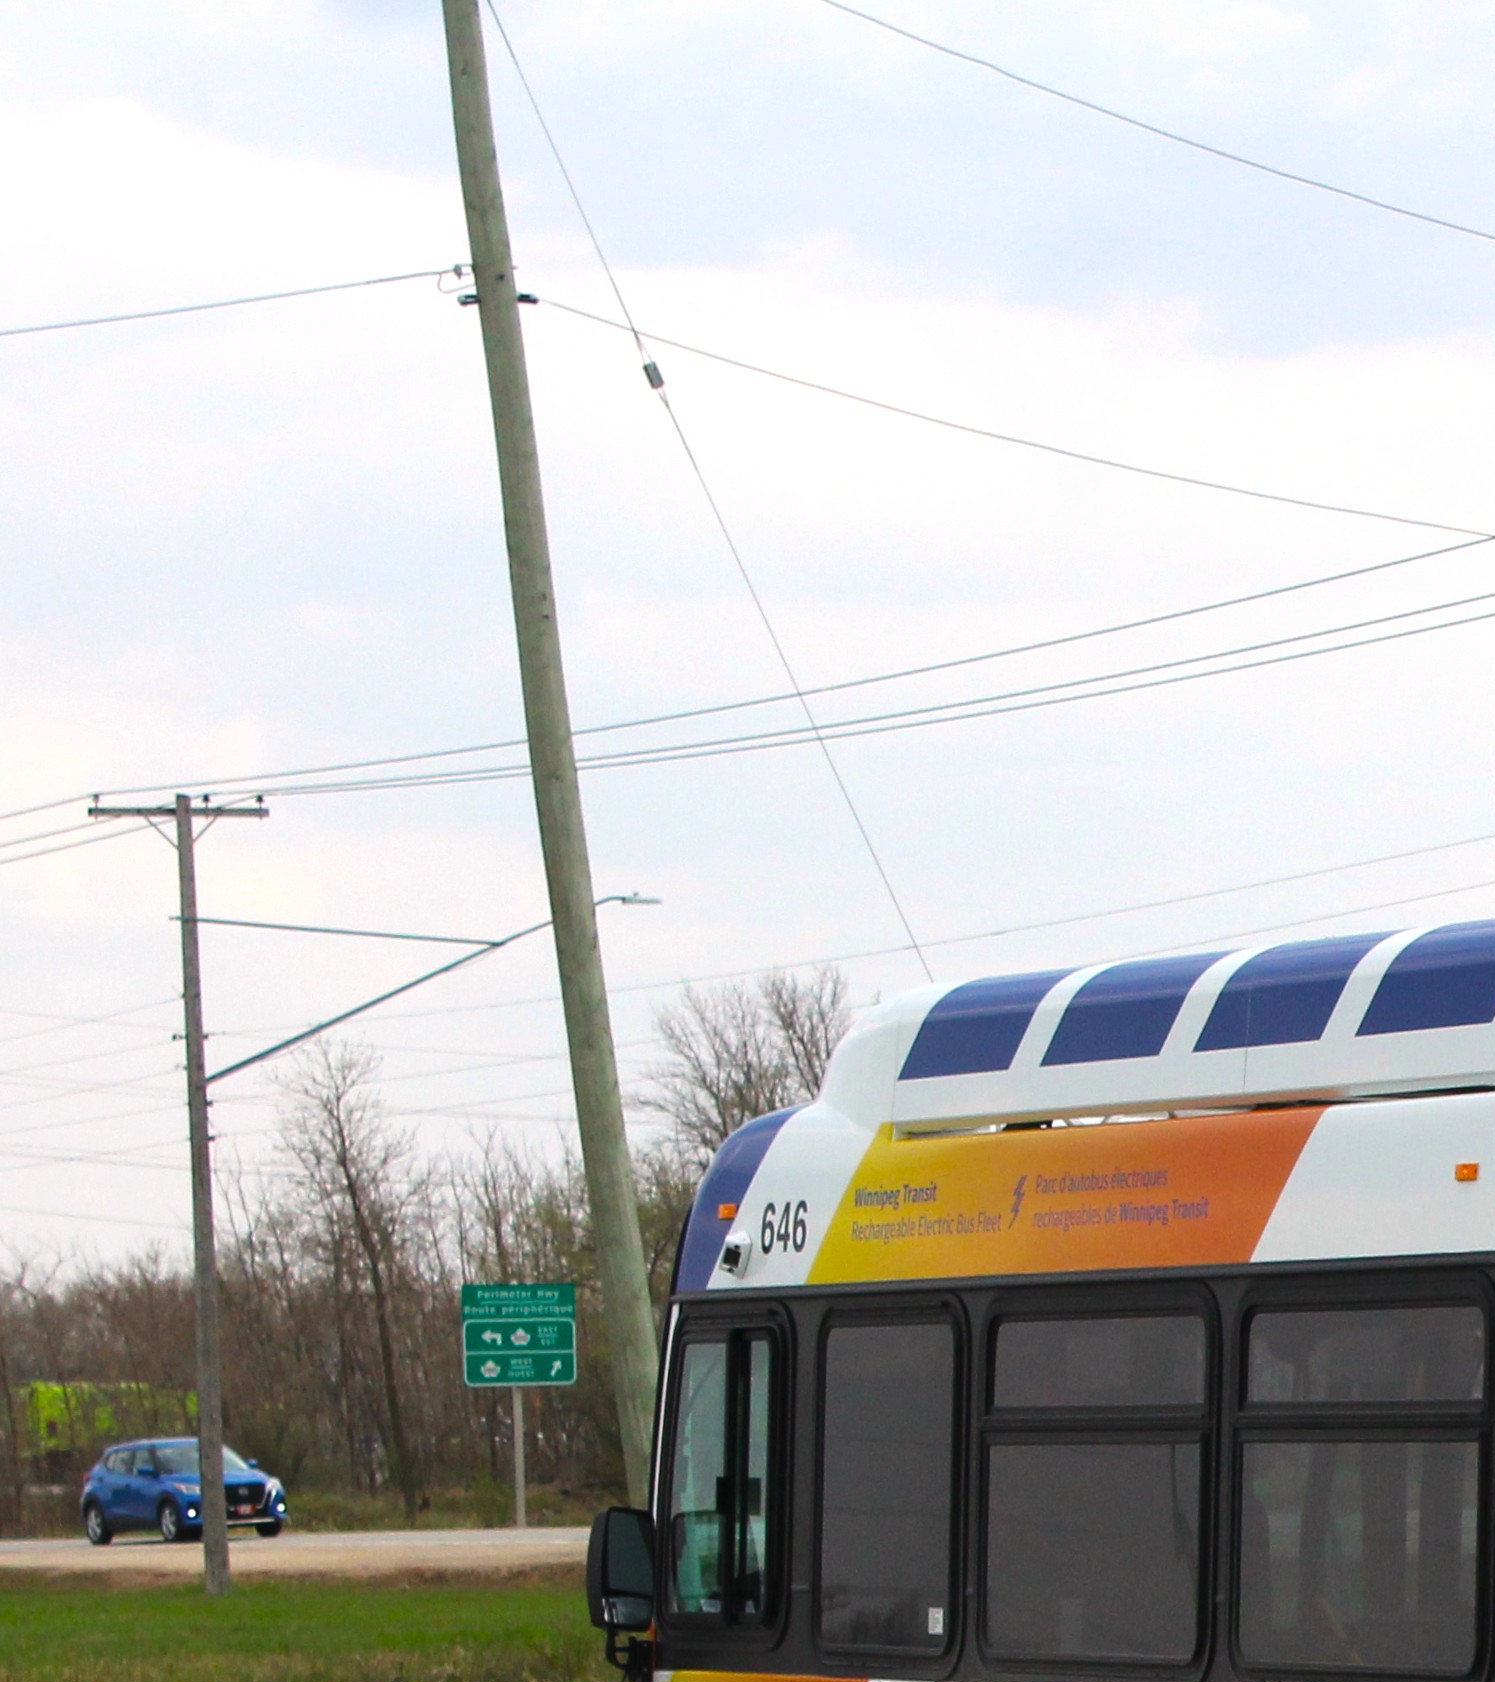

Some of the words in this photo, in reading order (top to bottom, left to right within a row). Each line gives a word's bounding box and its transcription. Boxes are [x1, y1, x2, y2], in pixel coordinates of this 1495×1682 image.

[1036, 1173, 1056, 1194] Parc
[1059, 1169, 1108, 1192] d'autobus
[1111, 1166, 1168, 1191] électriques
[855, 1184, 900, 1210] Winnipeg
[903, 1181, 937, 1203] Transit
[761, 1200, 808, 1255] 646
[852, 1217, 916, 1244] Rechargeable
[918, 1213, 954, 1236] Electric
[957, 1212, 974, 1234] Bus
[976, 1211, 1001, 1232] Fleet
[1033, 1203, 1101, 1232] rechargeables
[1104, 1204, 1118, 1224] de
[1119, 1200, 1168, 1225] Winnipeg
[1172, 1196, 1209, 1219] Transit
[464, 1305, 496, 1314] Route
[477, 1290, 531, 1299] Perimeter
[537, 1290, 559, 1300] Hwy
